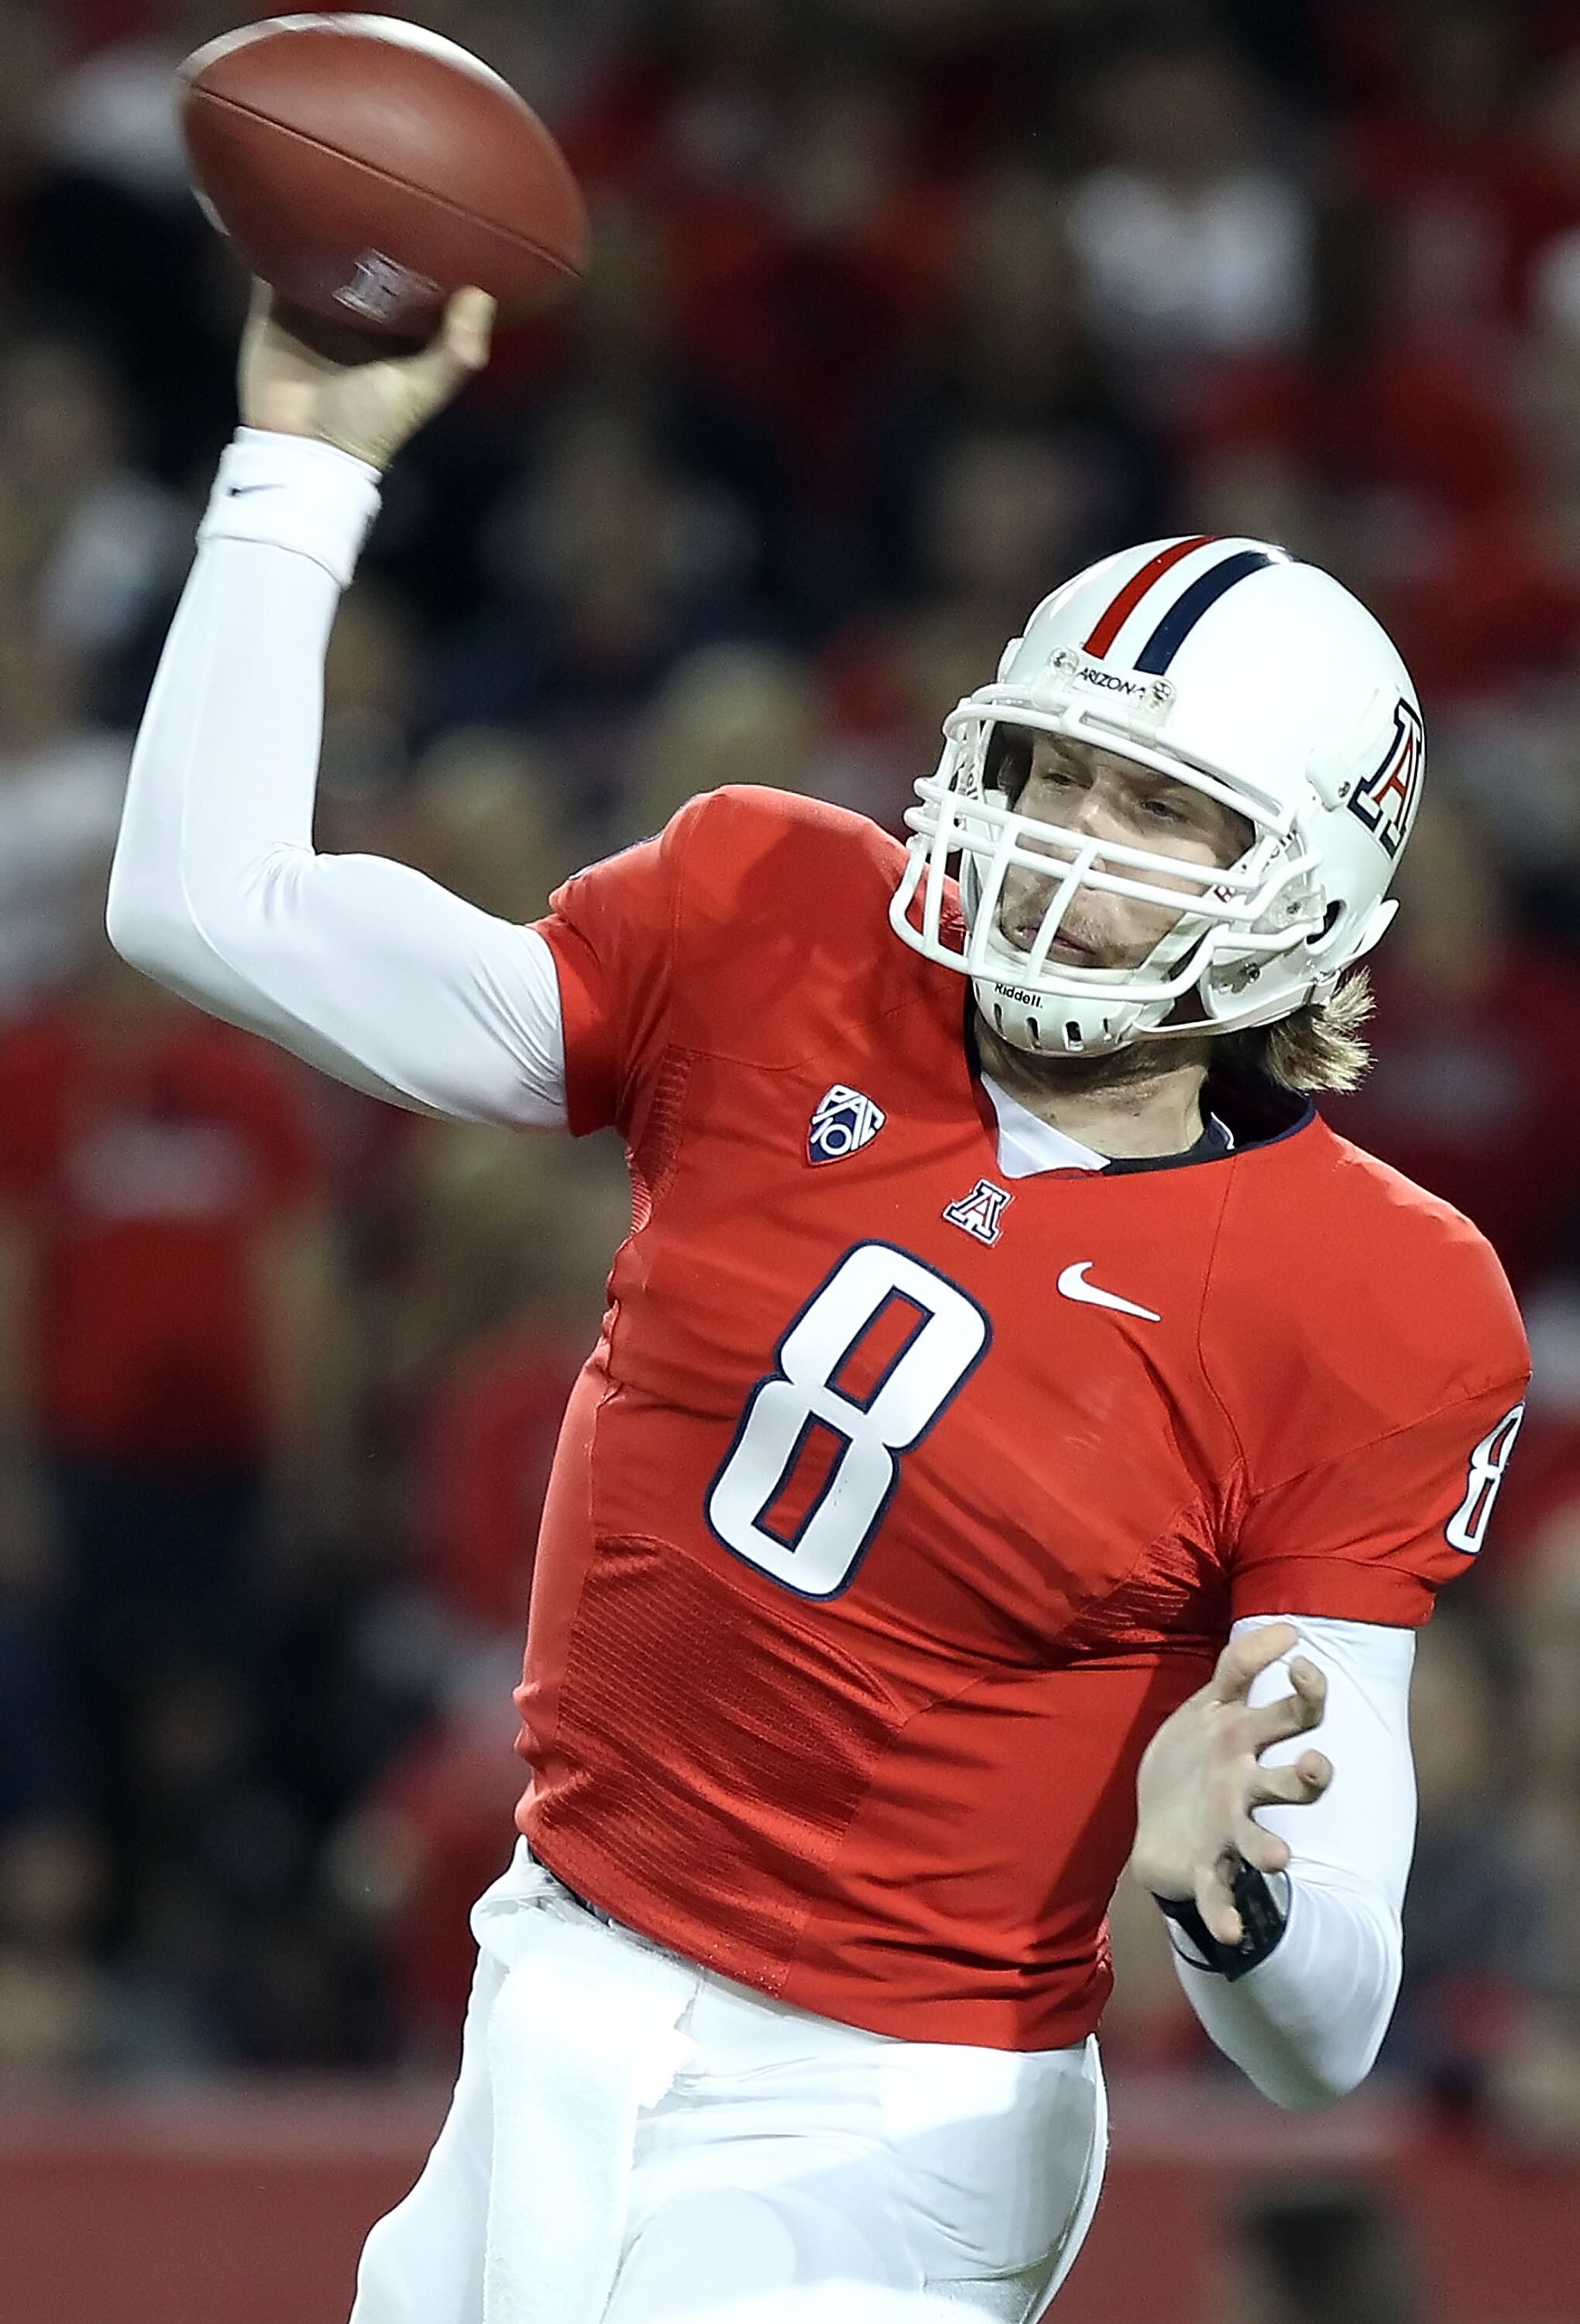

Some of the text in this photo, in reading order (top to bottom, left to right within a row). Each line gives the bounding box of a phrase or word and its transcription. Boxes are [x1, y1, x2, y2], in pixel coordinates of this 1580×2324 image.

[1077, 667, 1146, 699] ARIZONA
[1346, 697, 1423, 860] A
[943, 1178, 1011, 1246] A
[702, 1238, 994, 1602] 8
[1444, 1400, 1526, 1556] 8
